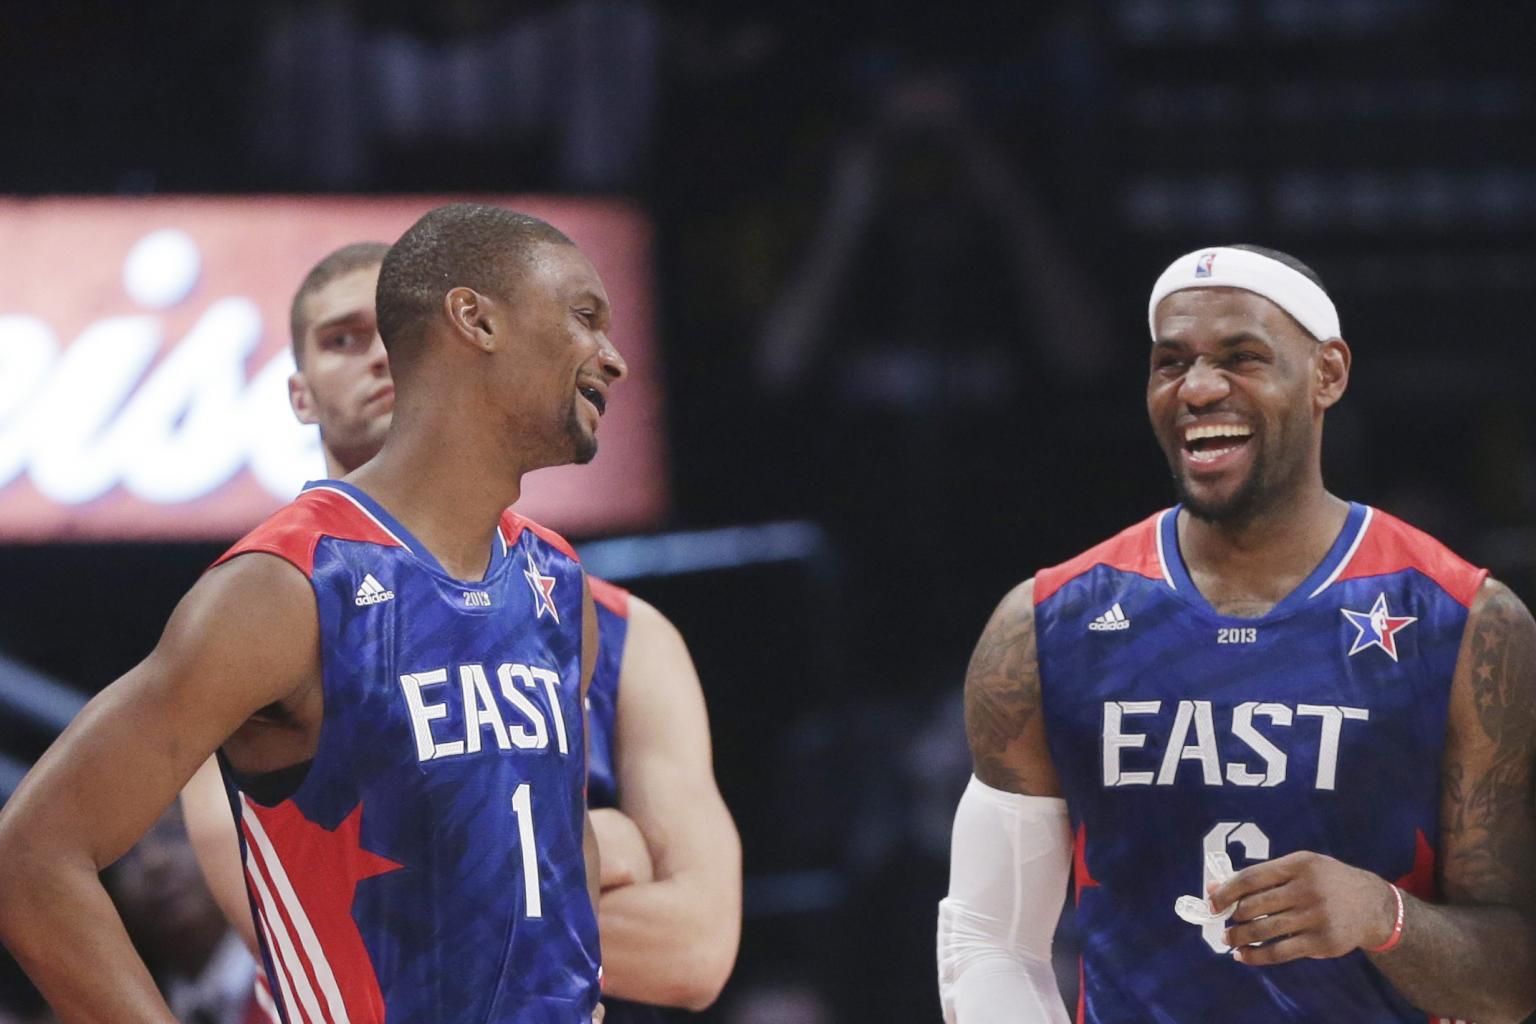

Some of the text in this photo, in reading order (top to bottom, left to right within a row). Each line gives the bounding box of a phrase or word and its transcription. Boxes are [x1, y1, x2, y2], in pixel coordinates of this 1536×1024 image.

[355, 589, 395, 606] adidas
[462, 591, 492, 607] 2013
[1088, 619, 1129, 630] adidas
[1217, 628, 1257, 644] 2013
[399, 663, 570, 762] EAST
[1102, 699, 1370, 791] EAST
[511, 783, 543, 918] 1
